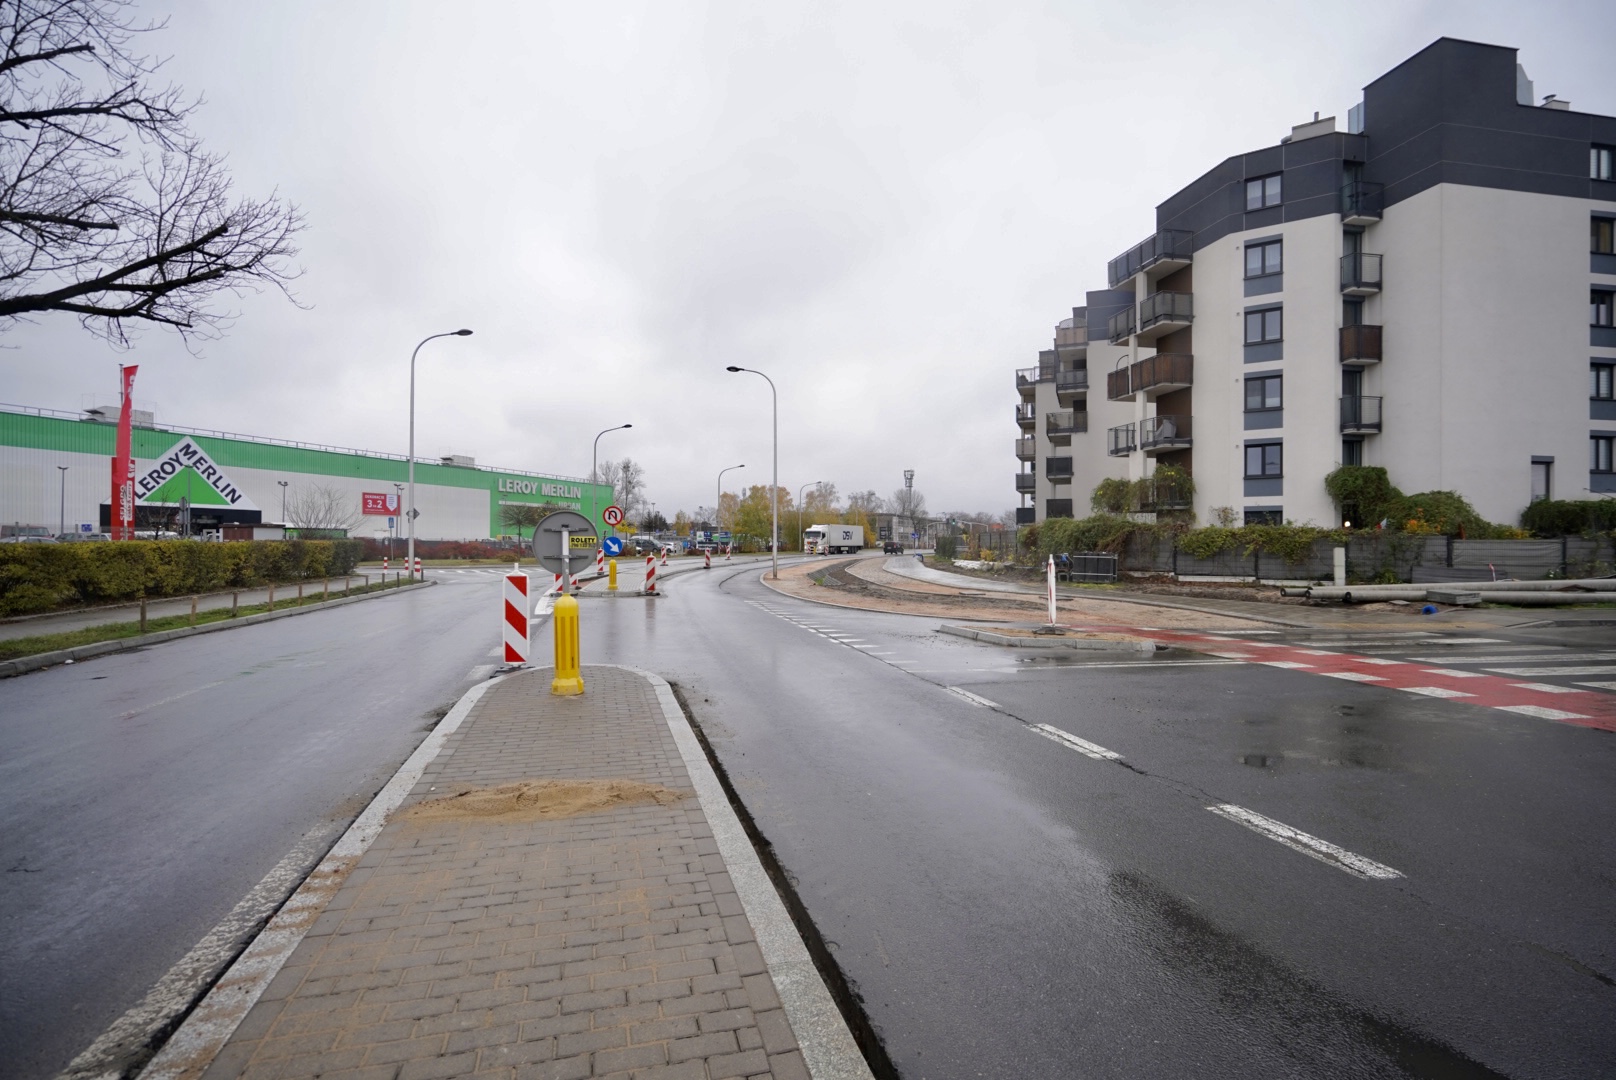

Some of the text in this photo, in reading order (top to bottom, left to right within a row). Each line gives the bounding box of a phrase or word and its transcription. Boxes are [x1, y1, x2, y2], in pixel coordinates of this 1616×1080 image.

[134, 443, 242, 504] LEROY MERLIN
[498, 478, 581, 499] LEROY MERLIN
[367, 499, 373, 508] 3
[376, 500, 383, 508] 2
[842, 530, 854, 540] DSV
